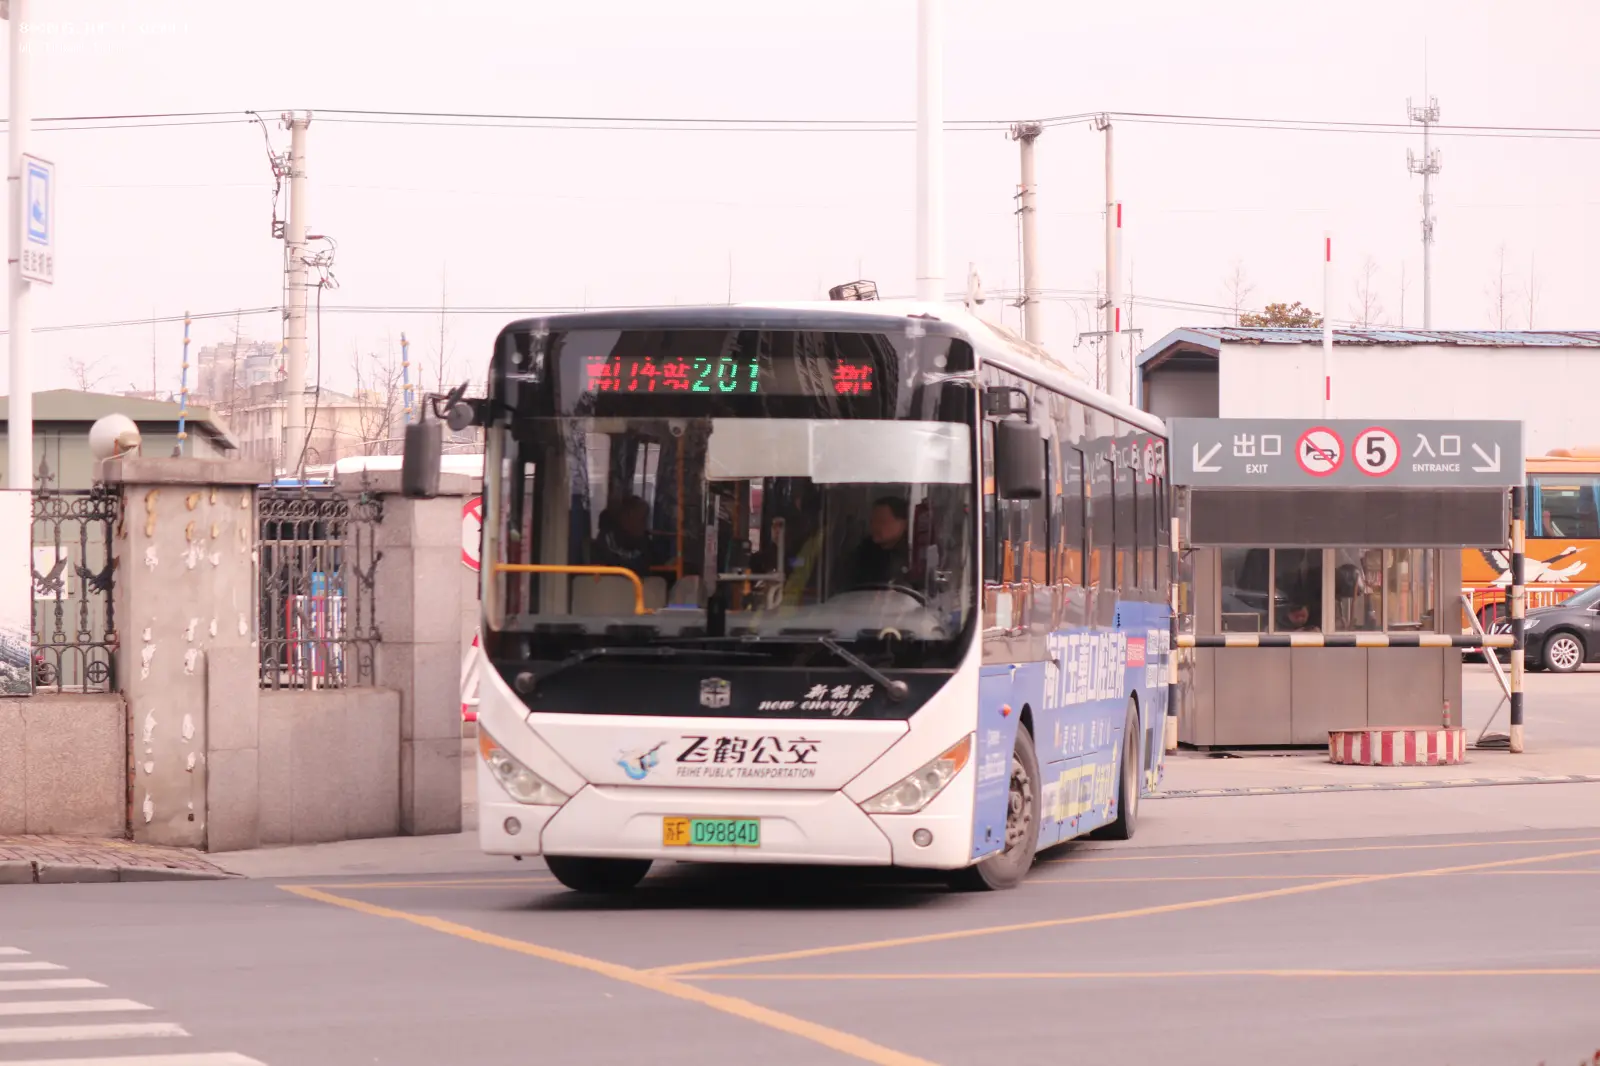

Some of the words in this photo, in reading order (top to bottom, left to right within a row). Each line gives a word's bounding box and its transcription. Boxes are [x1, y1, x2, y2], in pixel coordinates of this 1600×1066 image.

[692, 357, 759, 392] 201
[1233, 433, 1281, 457] 出口
[1366, 436, 1387, 467] 5
[1412, 433, 1461, 458] 入口
[1245, 463, 1268, 474] EXIT
[1412, 463, 1460, 473] ENTRANCE
[804, 683, 874, 700] 新能源
[758, 699, 797, 711] new
[800, 698, 864, 716] energy
[676, 735, 821, 764] 飞鹤公交
[676, 766, 701, 777] FEIHE
[703, 767, 736, 778] PUBLIC
[736, 767, 816, 778] TRANSPORTATION
